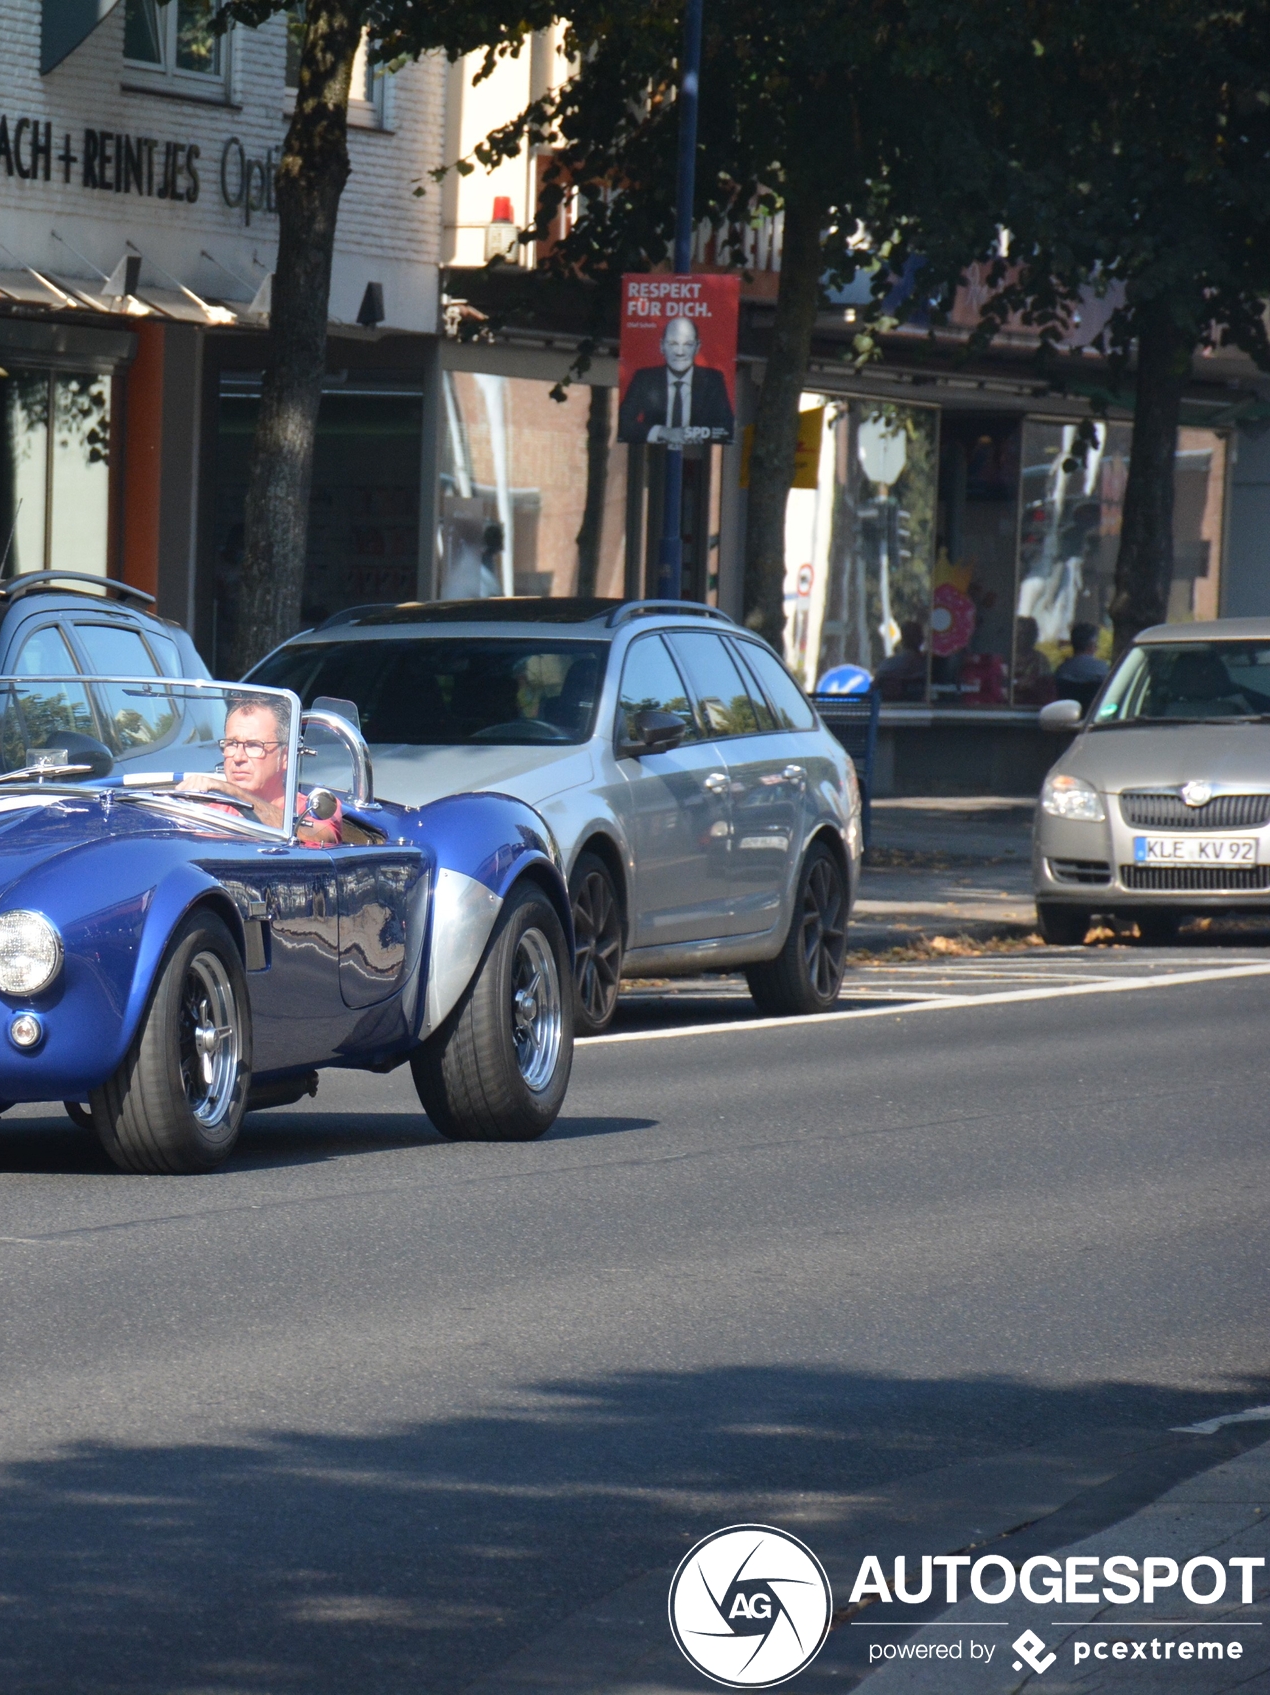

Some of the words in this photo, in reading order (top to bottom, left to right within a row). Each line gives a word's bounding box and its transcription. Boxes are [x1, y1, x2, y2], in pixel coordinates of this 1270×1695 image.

[83, 128, 201, 204] REINTJES
[221, 136, 284, 228] Opt
[628, 282, 702, 298] RESPEKT
[627, 298, 661, 317] FÜR
[666, 302, 712, 317] DICH.
[684, 426, 711, 440] SPD
[1147, 841, 1185, 859] KLE
[1199, 842, 1224, 859] KV
[1229, 842, 1253, 860] 92
